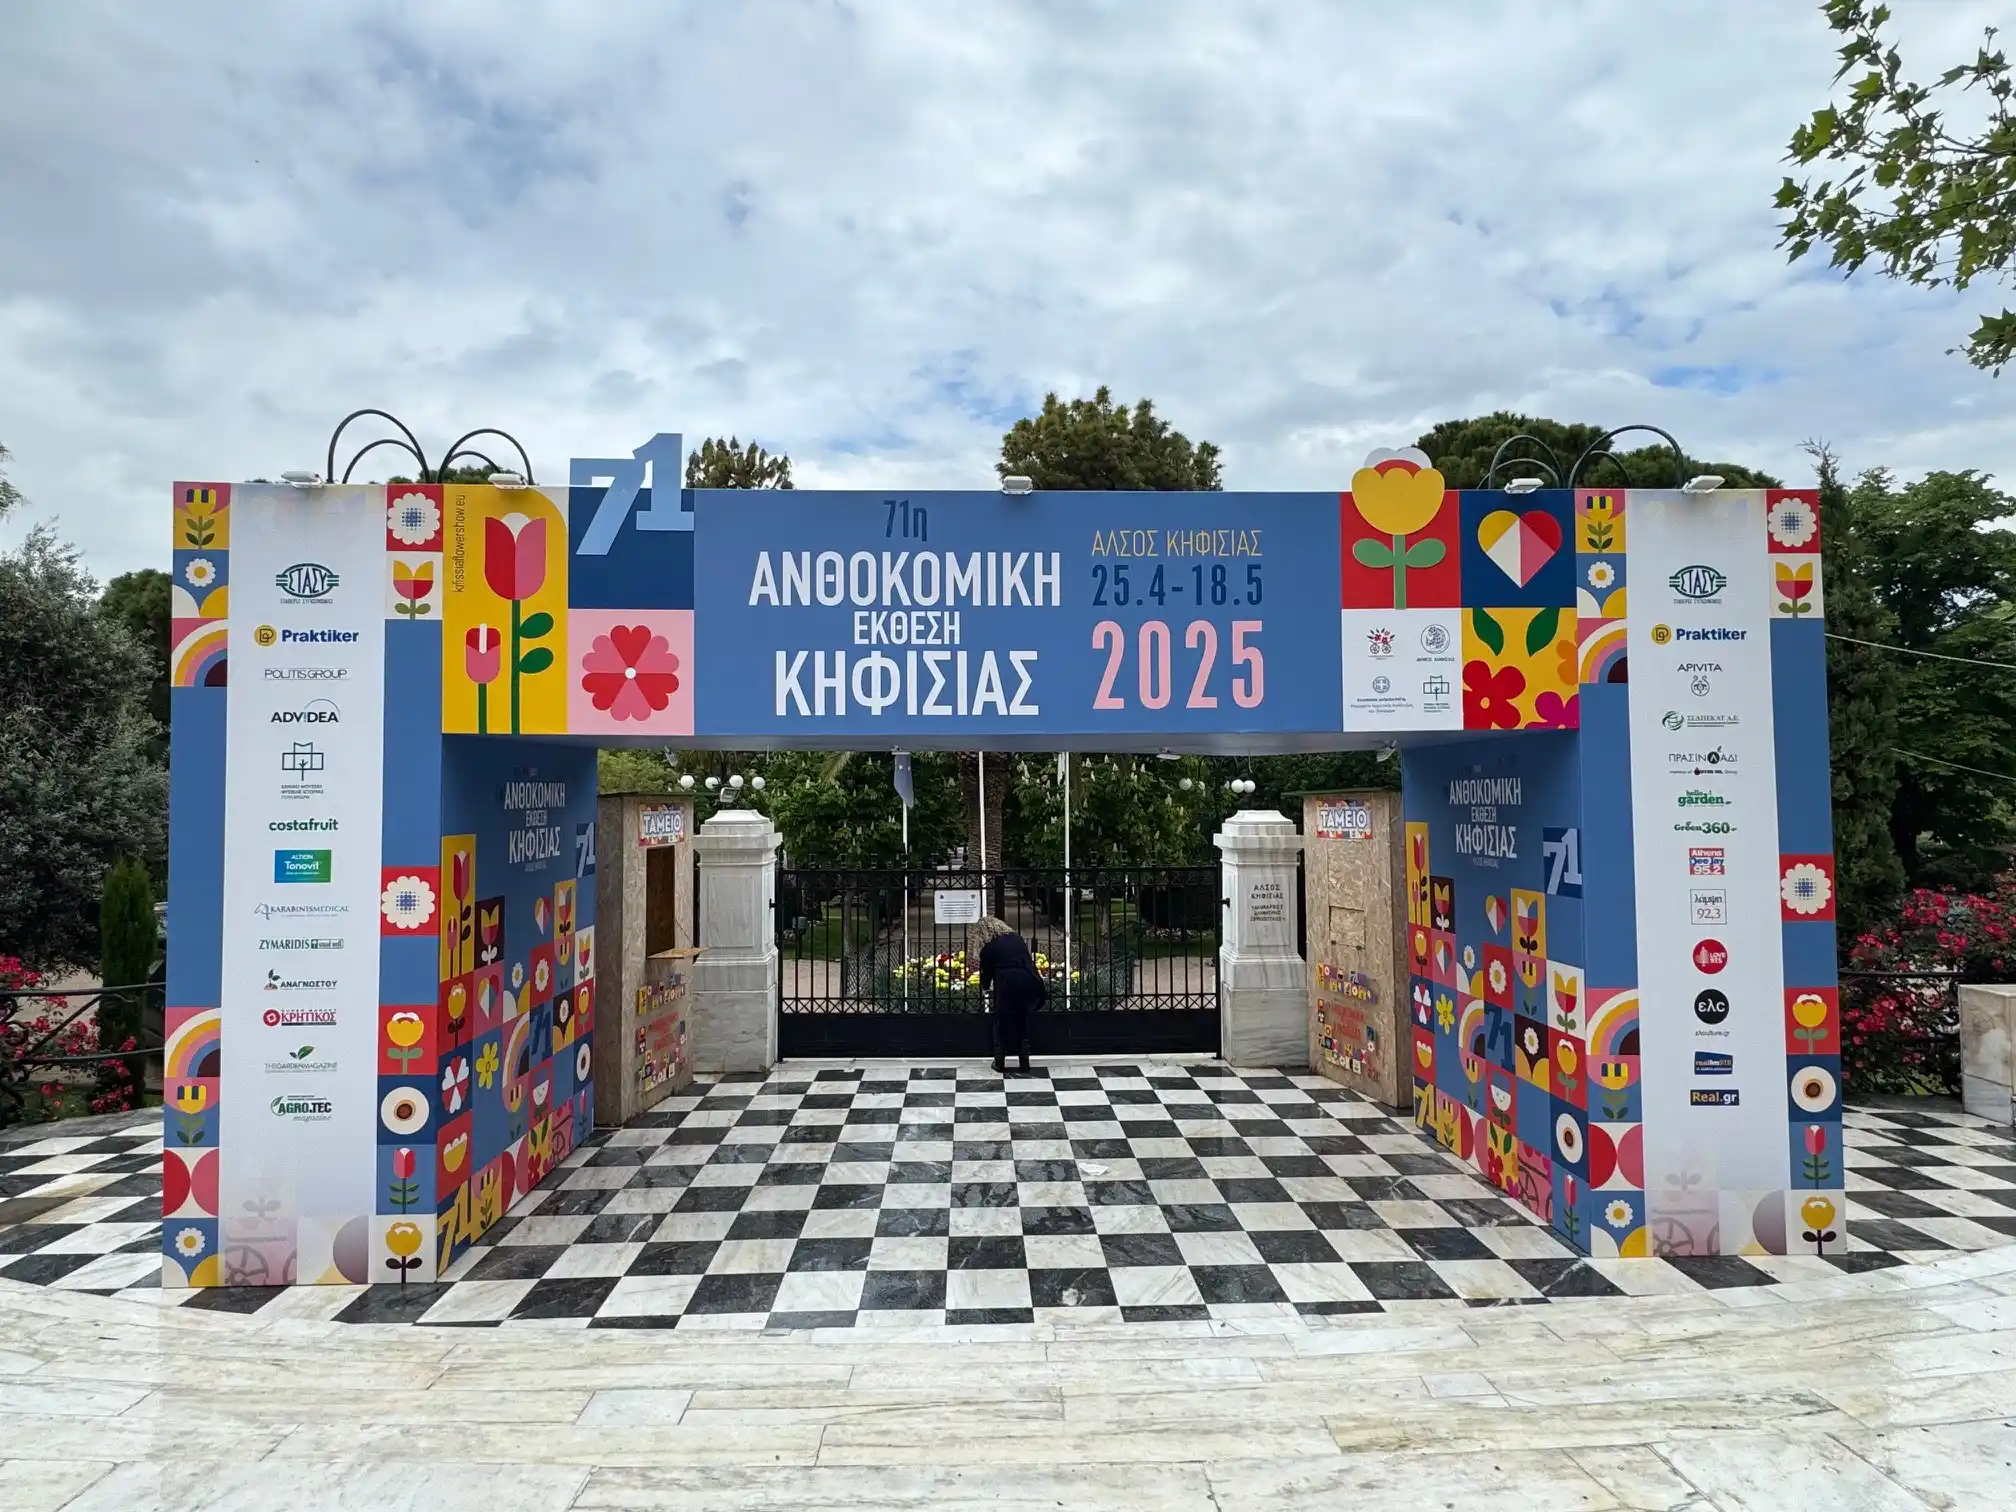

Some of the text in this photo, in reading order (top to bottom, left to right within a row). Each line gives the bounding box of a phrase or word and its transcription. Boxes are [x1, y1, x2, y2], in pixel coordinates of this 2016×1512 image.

[570, 433, 694, 555] 71
[883, 500, 928, 542] 71η
[452, 494, 466, 593] kifissiaflowershow.eu
[1091, 530, 1263, 557] ΑΛΣΟΣ ΚΗΦΙΣΙΑΣ
[288, 568, 328, 594] ΣΤΑΣΥ
[749, 551, 1061, 606] ΑΝΘΟΚΟΜΙΚΗ
[1680, 570, 1716, 595] ΣΤΑΣΥ
[281, 629, 359, 643] Praktiker
[854, 611, 960, 645] ΕΚΘΕΣΗ
[1676, 628, 1747, 641] Praktiker
[1092, 620, 1264, 710] 2025
[1677, 663, 1723, 672] APIVITA
[775, 650, 1039, 716] ΚΗΦΙΣΙΑΣ
[504, 781, 566, 810] ΑΝΘΟΚΟΜΙΚΗ
[1449, 777, 1522, 806] ΑΝΘΟΚΟΜΙΚΗ
[269, 818, 339, 831] costafruit
[643, 814, 682, 834] ΤΑΜΕΙΟ
[1320, 810, 1367, 828] ΤΑΜΕΙΟ
[1471, 806, 1497, 823] ΕΚΘΕΣΗ
[508, 826, 561, 864] ΚΗΦΙΣΙΑΣ
[1455, 823, 1518, 859] ΚΗΦΙΣΙΑΣ
[259, 939, 310, 950] ZYMARIDIS
[280, 980, 338, 988] ΑΝΑΓΝΩΣΤΟΥ
[281, 1012, 337, 1022] ΚΡΗΤΙΚΟΣ
[278, 1102, 333, 1114] AGRO.TEC
[1692, 1092, 1737, 1105] Real.gr
